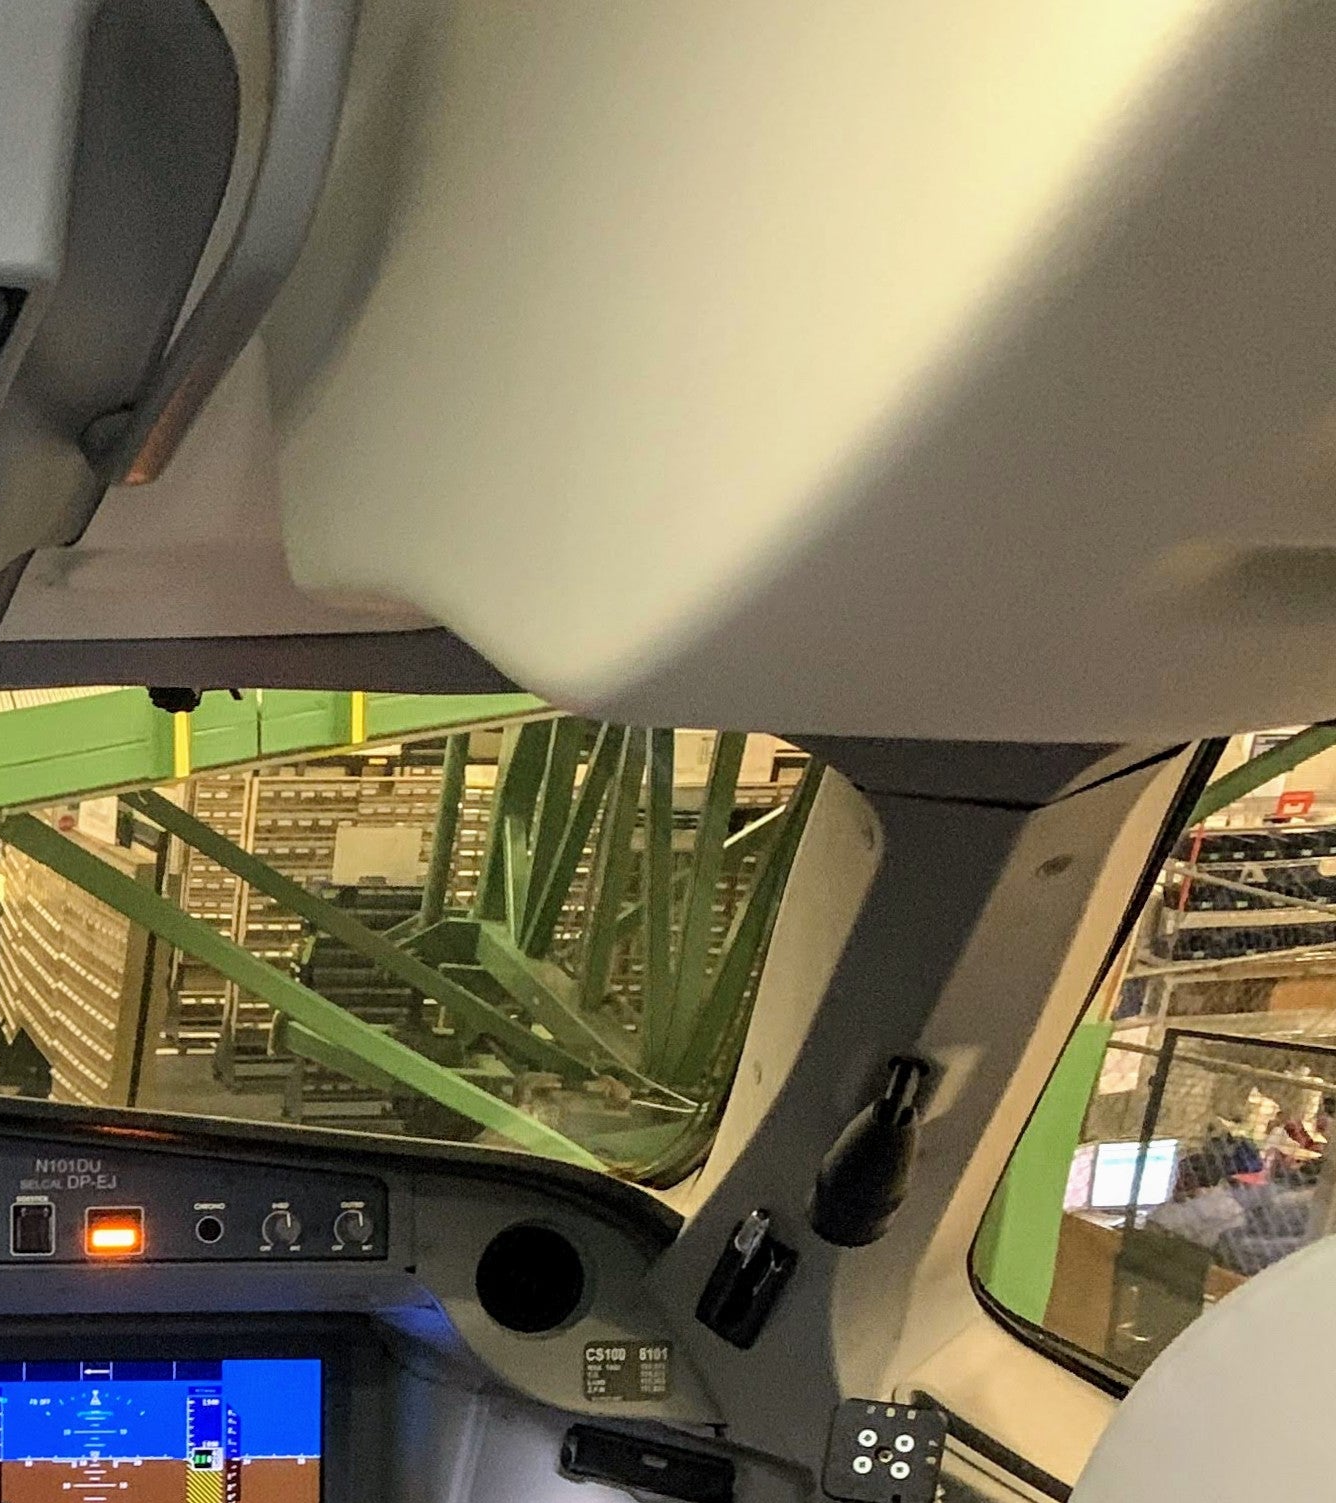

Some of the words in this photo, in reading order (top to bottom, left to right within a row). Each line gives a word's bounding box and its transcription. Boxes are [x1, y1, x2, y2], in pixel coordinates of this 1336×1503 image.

[35, 1158, 102, 1173] N101DU
[67, 1175, 118, 1190] DP-EJ
[585, 1347, 626, 1362] CS100
